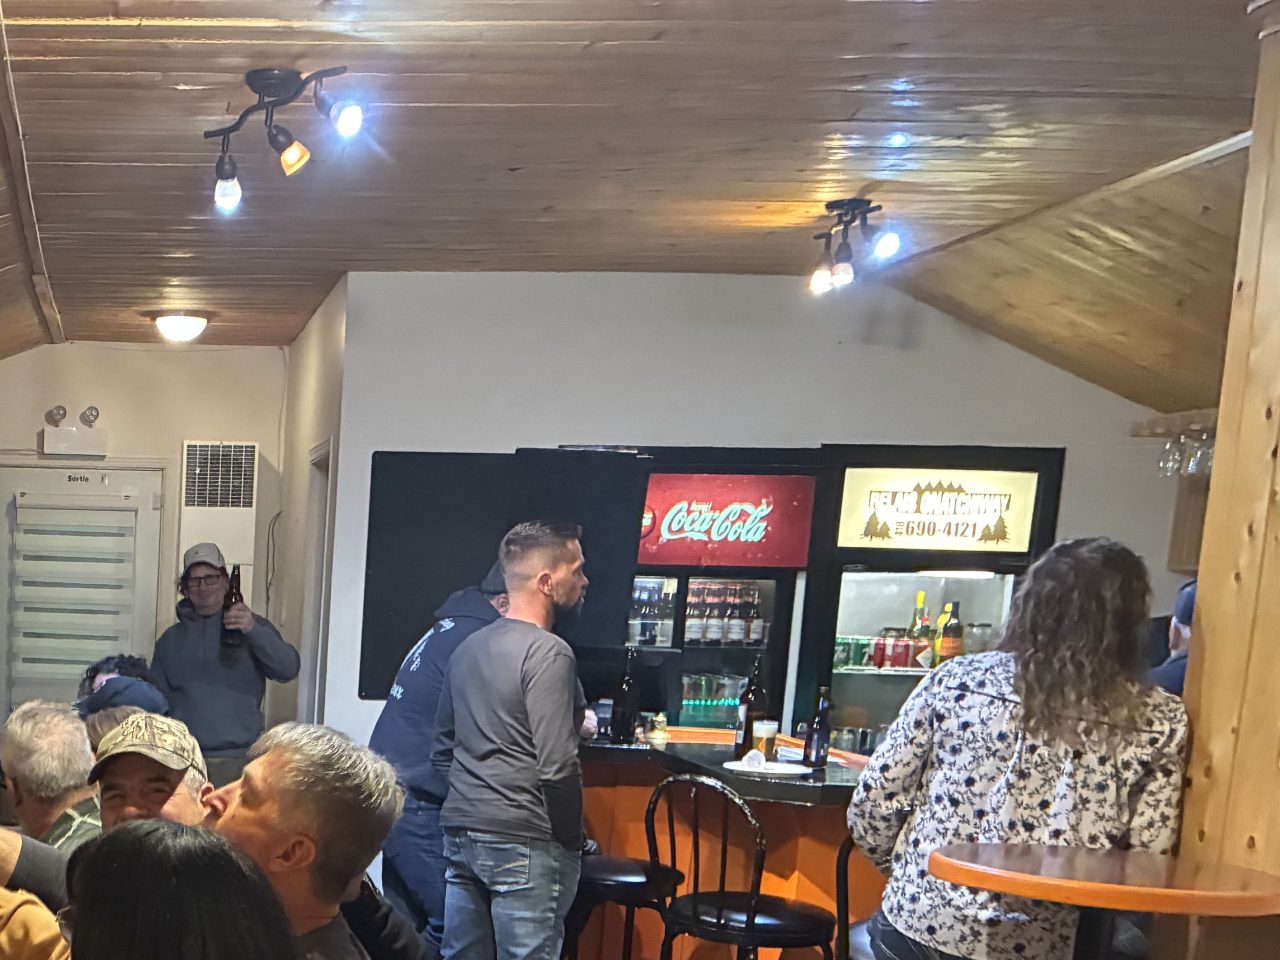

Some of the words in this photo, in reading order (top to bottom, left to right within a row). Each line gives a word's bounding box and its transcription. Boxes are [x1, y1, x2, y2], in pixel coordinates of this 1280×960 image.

[67, 474, 90, 483] Sortie
[660, 500, 774, 543] Coca-Cola
[905, 520, 977, 538] 690-4121
